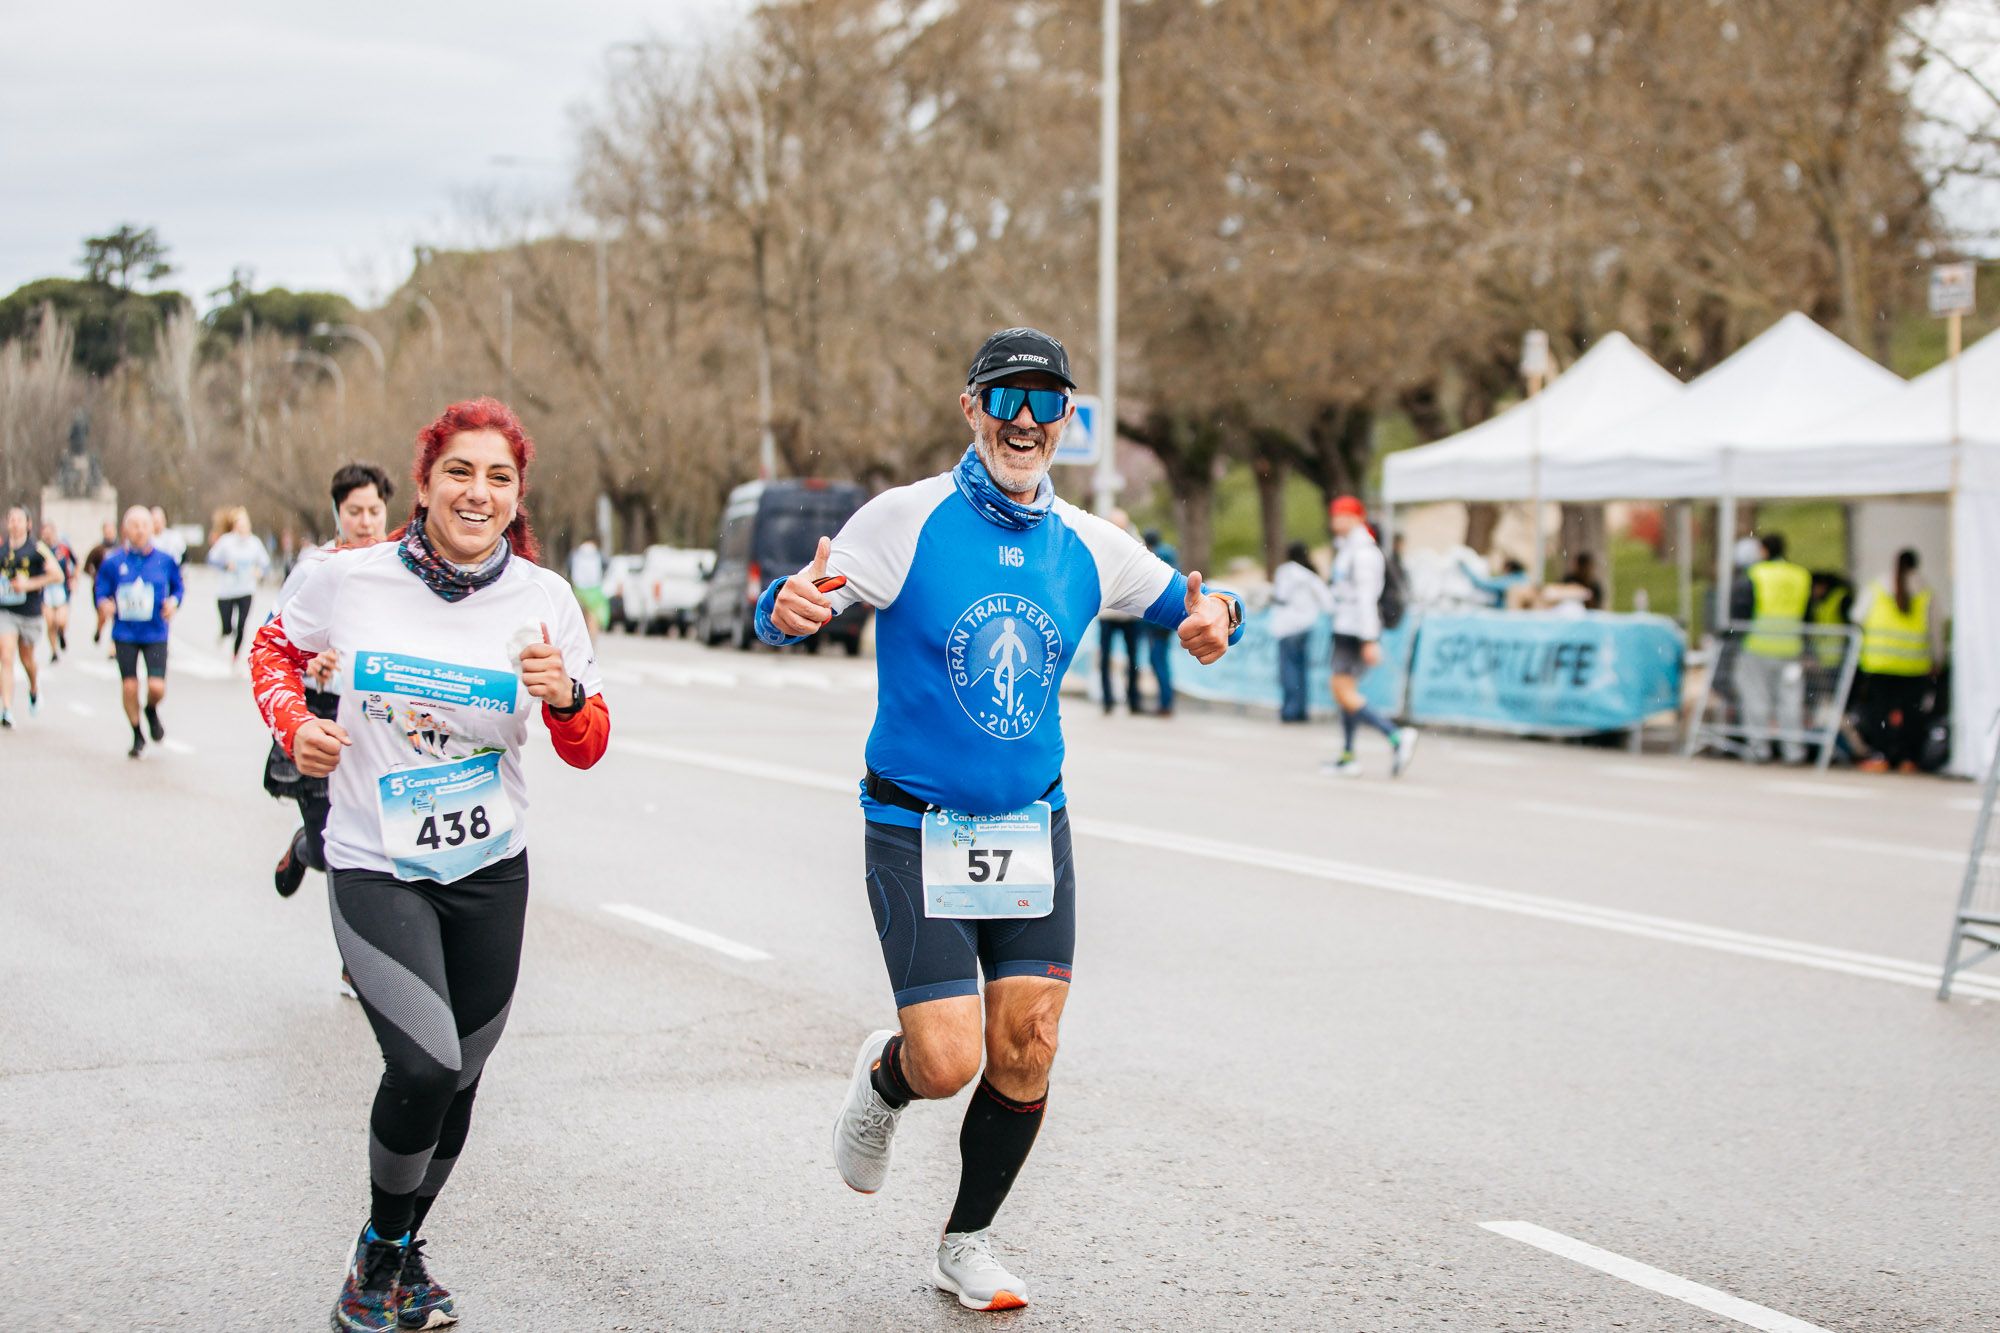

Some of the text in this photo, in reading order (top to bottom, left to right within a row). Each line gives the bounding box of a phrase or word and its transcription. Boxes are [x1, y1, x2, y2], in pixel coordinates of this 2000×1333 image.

[1017, 354, 1049, 366] TERREX
[950, 598, 1059, 687] GRAN TRAIL PEÑALARA
[383, 661, 431, 676] Carrera
[433, 668, 487, 685] Solidaria
[425, 688, 432, 696] 7
[468, 695, 509, 713] 2026
[986, 712, 1031, 734] 2015
[406, 776, 448, 789] Carrera
[448, 765, 485, 782] Solidaria
[416, 805, 491, 850] 438
[951, 812, 987, 822] Carrera
[989, 812, 1030, 822] Solidaria
[968, 849, 1013, 883] 57
[1017, 899, 1030, 907] CSL
